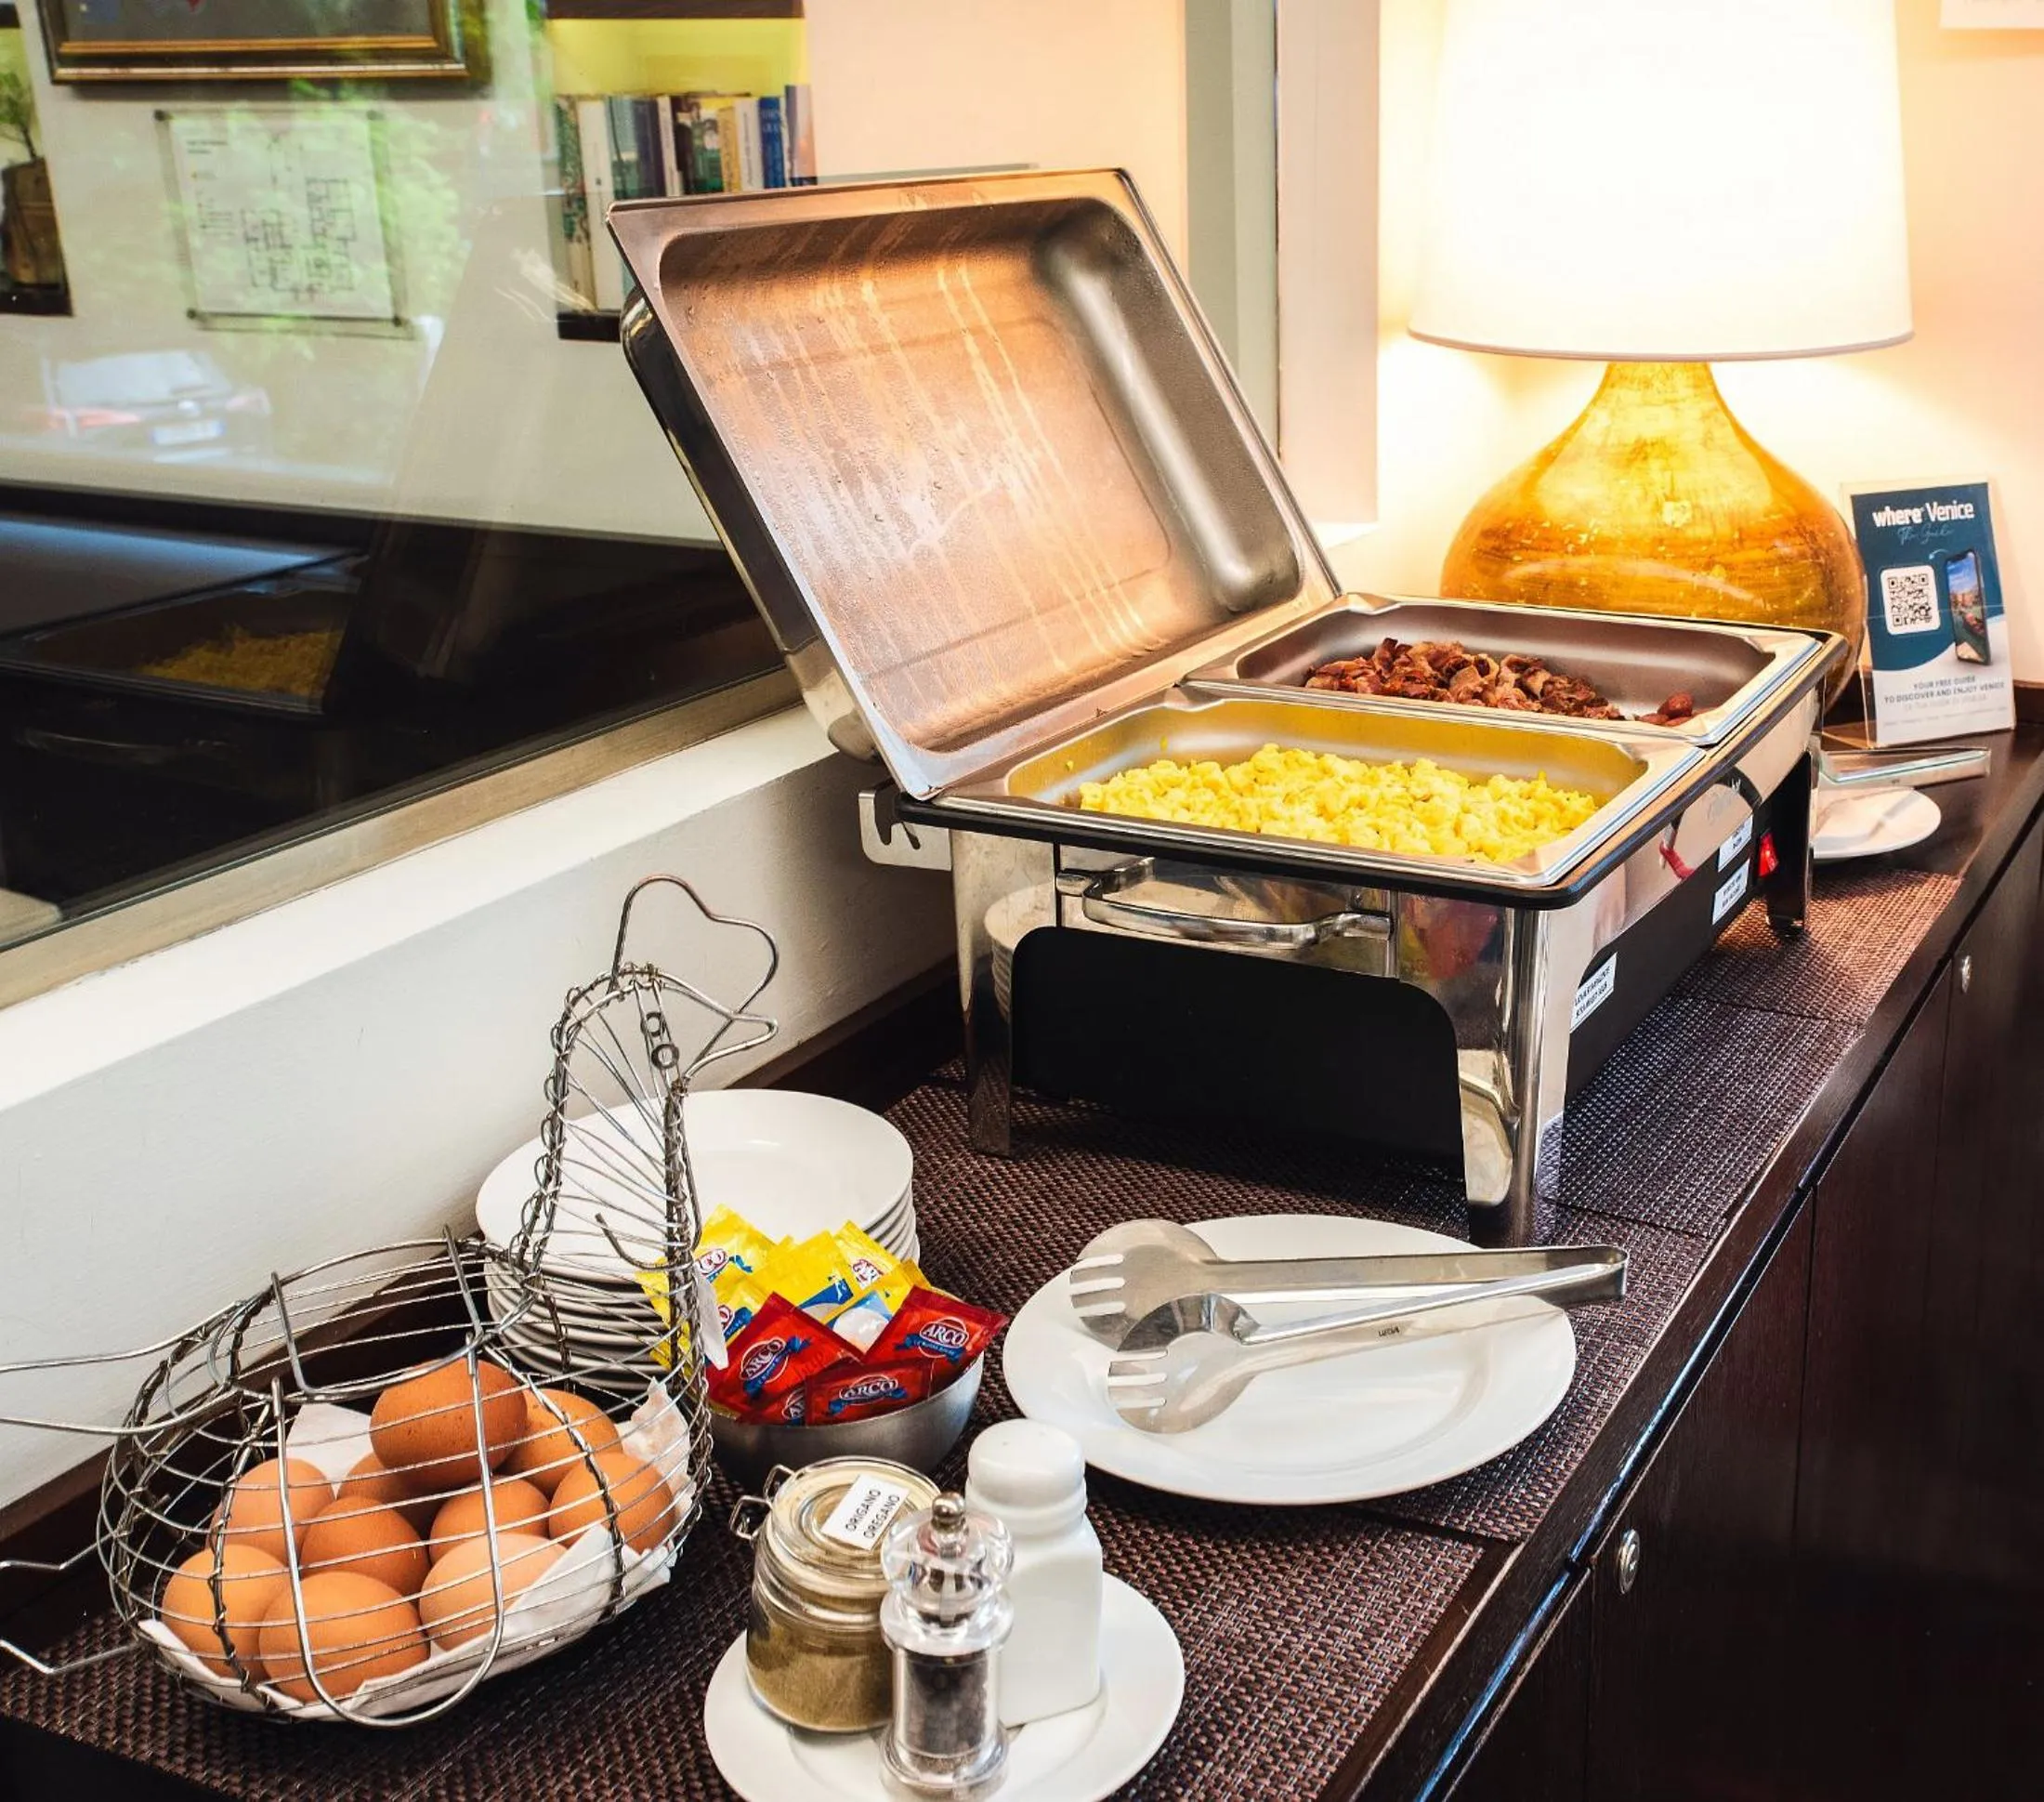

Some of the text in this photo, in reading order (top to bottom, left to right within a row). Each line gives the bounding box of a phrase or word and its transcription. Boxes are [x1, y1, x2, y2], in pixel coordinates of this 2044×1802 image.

[1872, 500, 1974, 527] where Venice
[1884, 695, 1894, 704] TO
[1896, 691, 1933, 703] DISCOVER
[1936, 688, 1951, 697] AND
[1953, 685, 1977, 695] ENJOY
[922, 1323, 965, 1347] ARCO
[745, 1340, 782, 1377] ARCO
[844, 1379, 895, 1398] ARCO
[845, 1489, 881, 1532] ORIGANO
[863, 1494, 900, 1539] OREGANO
